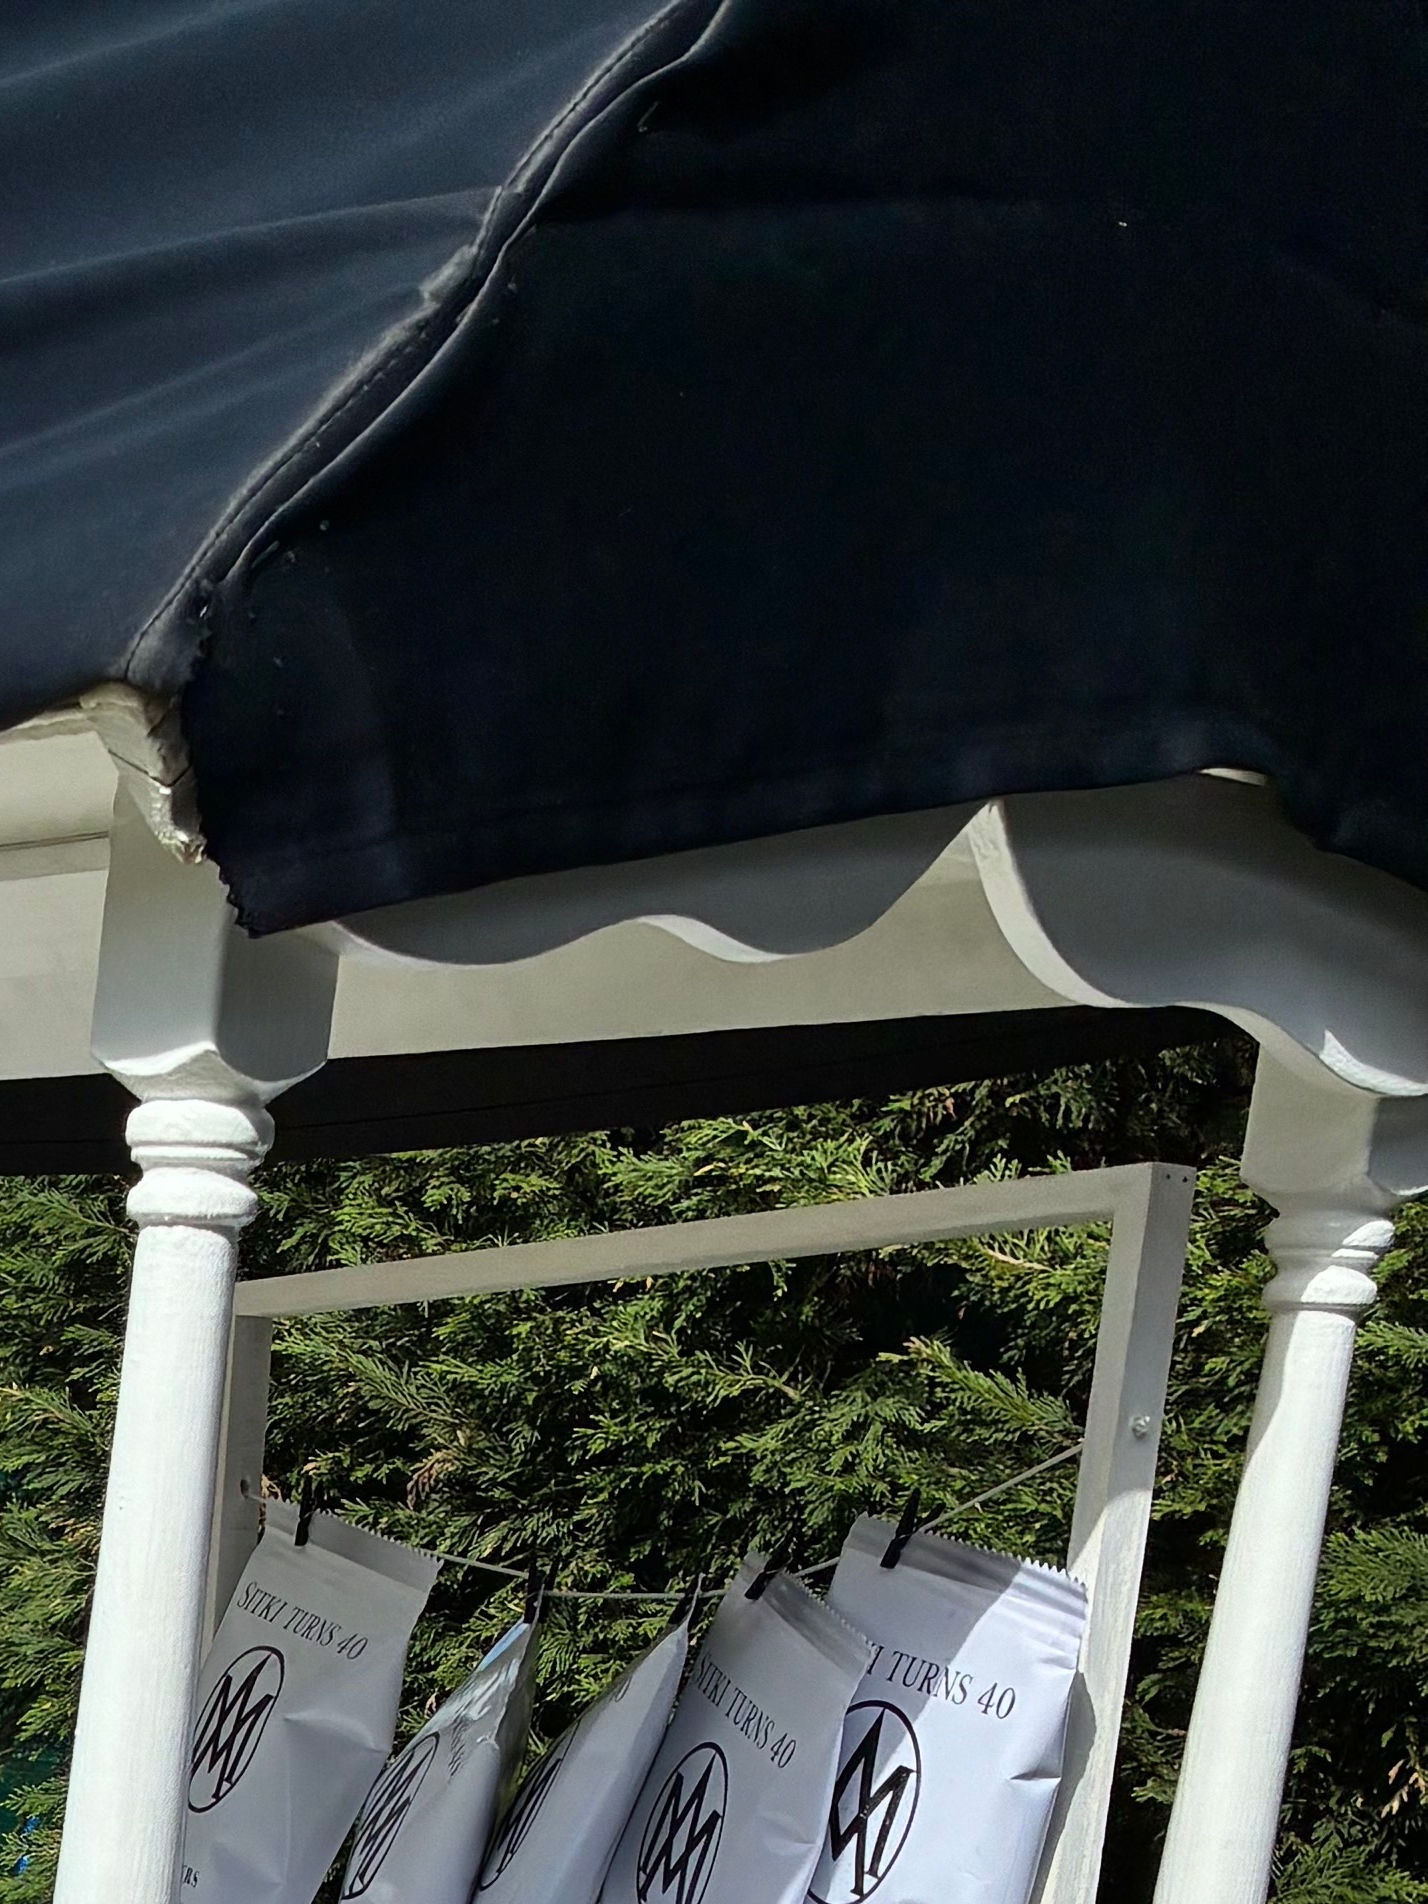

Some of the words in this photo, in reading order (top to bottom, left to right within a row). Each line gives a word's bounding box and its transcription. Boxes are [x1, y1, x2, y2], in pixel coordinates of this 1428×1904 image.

[237, 1581, 288, 1623] SITKI
[283, 1606, 342, 1646] TURNS
[337, 1633, 369, 1660] 40
[696, 1655, 730, 1708] SITKI
[724, 1687, 775, 1750] TURNS
[770, 1732, 797, 1768] 40
[887, 1650, 973, 1705] TURNS
[977, 1682, 1016, 1719] 40
